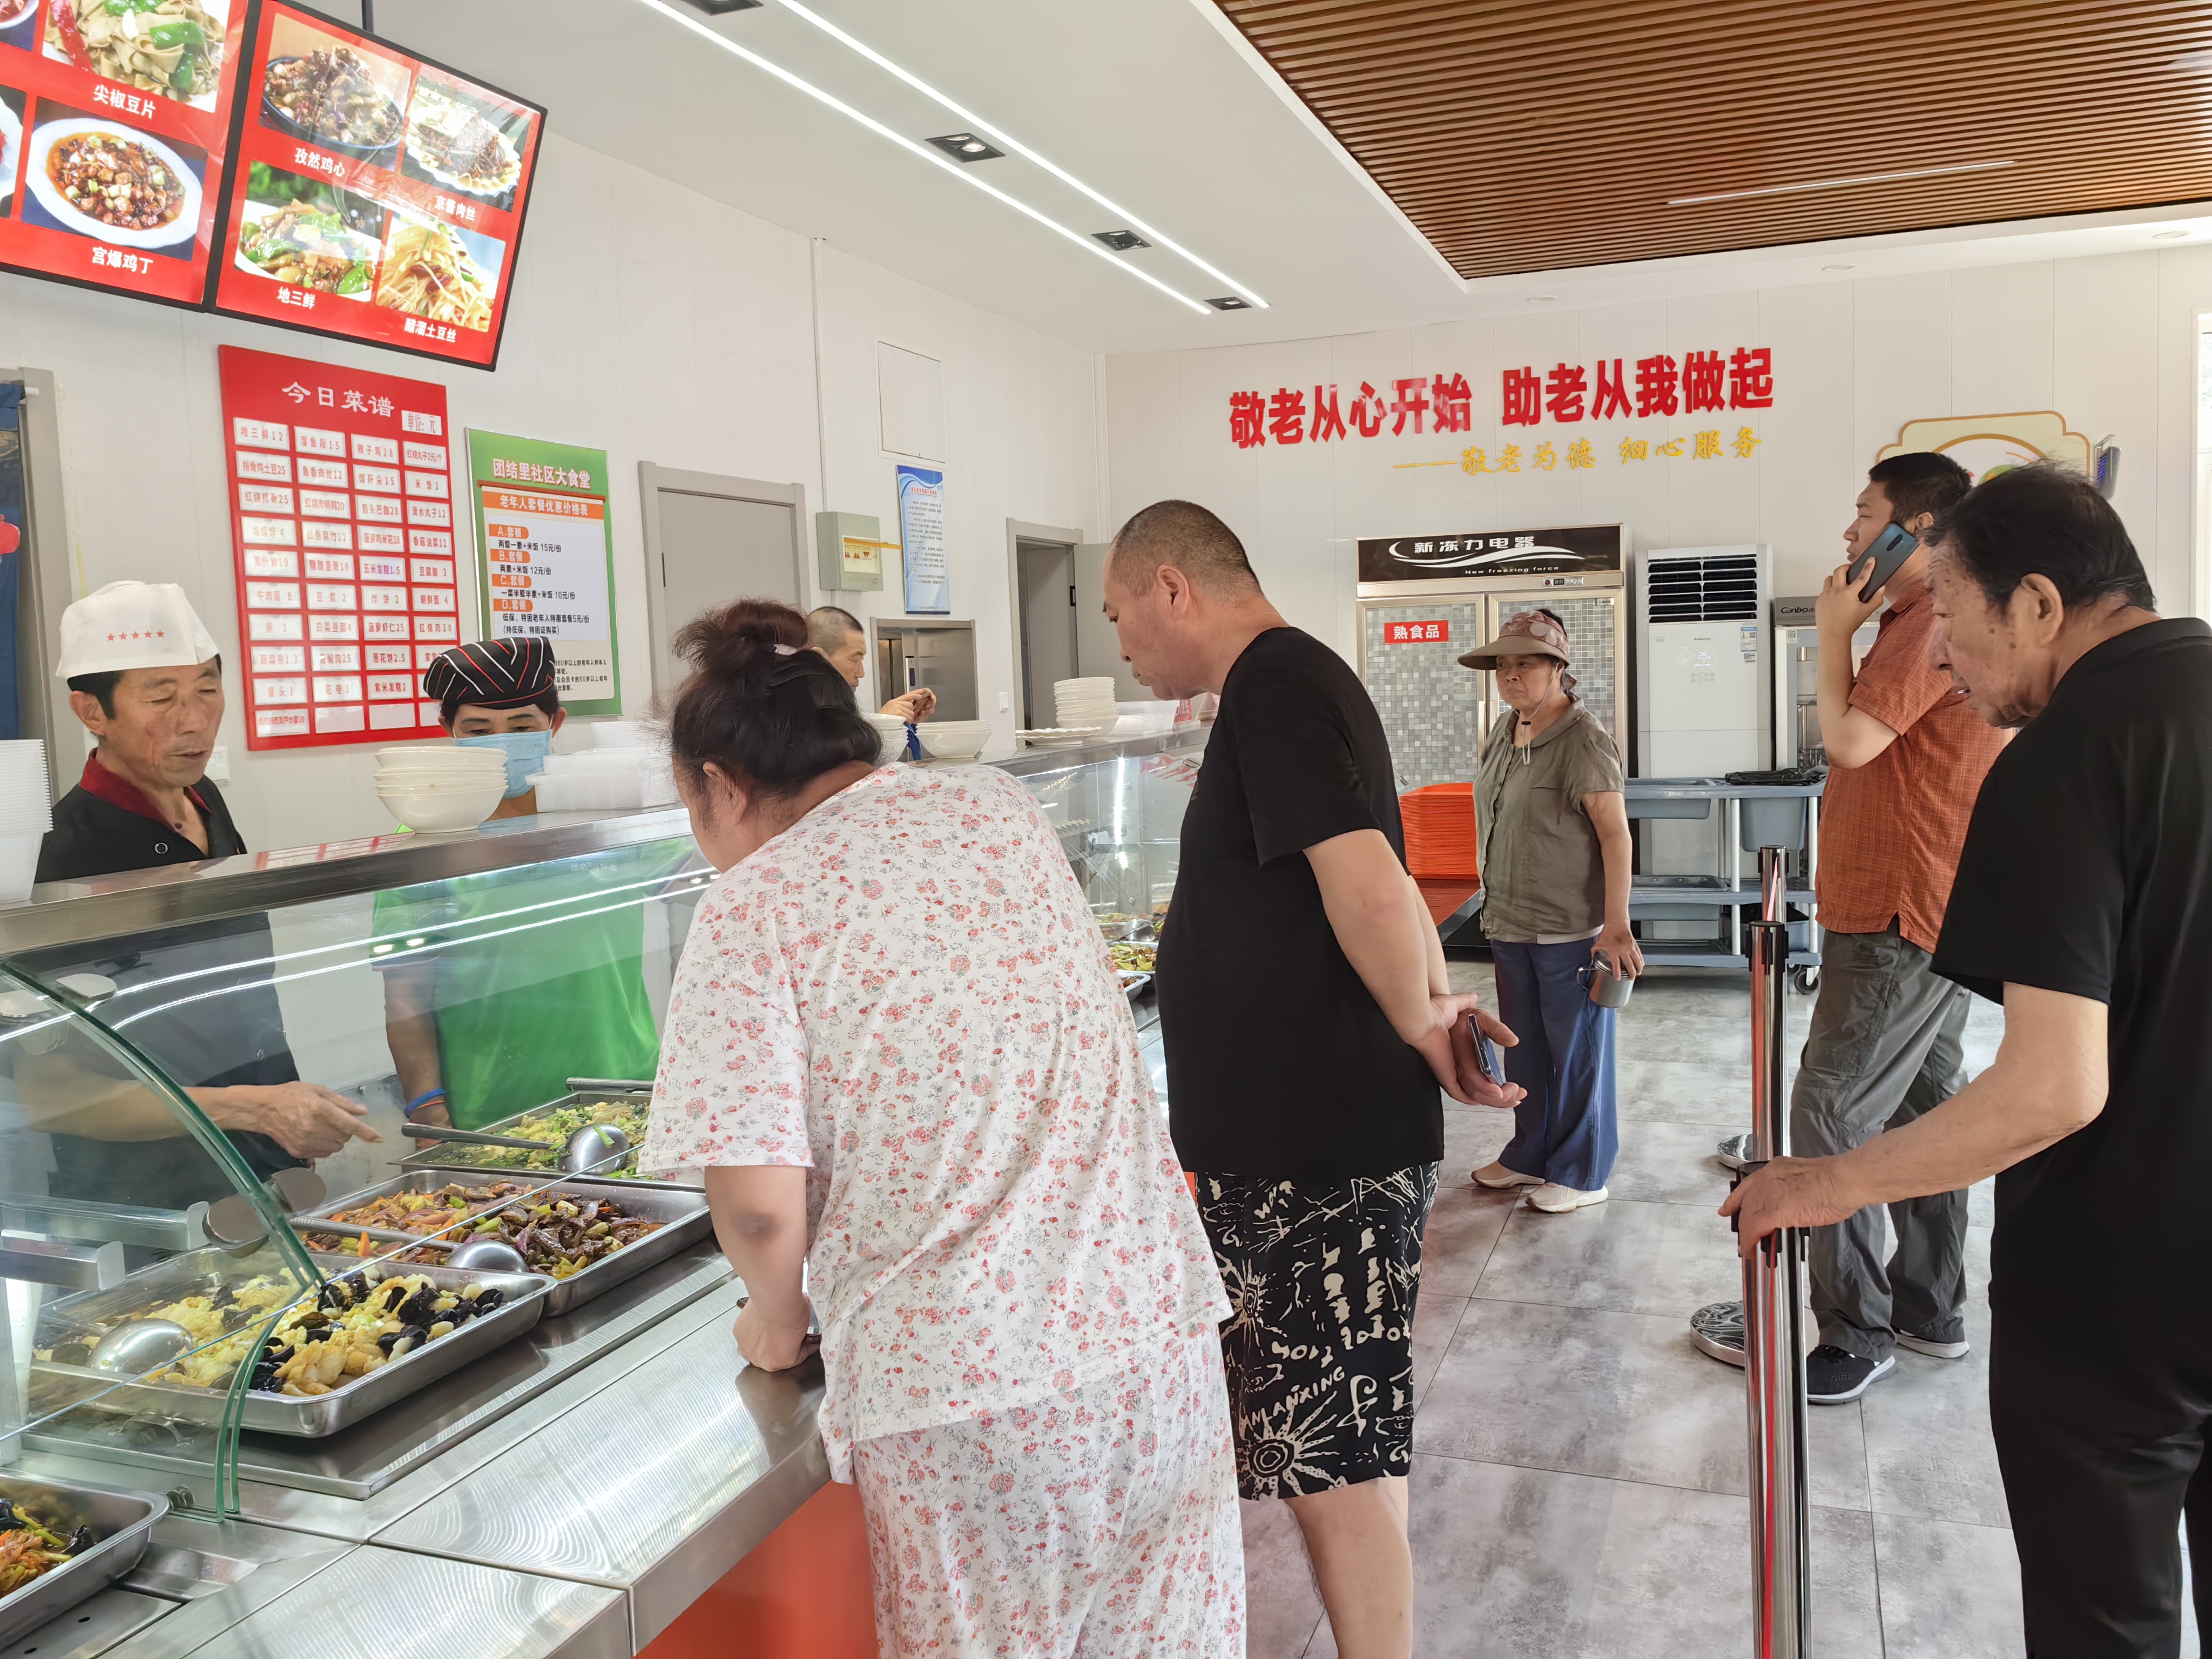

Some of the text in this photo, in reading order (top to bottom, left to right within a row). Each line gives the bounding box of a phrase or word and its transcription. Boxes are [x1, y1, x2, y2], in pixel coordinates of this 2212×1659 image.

[93, 84, 156, 119] 尖椒豆片
[295, 147, 346, 177] 孜然鸡心
[435, 195, 476, 221] 京酱肉丝
[91, 247, 153, 274] 宫爆鸡丁
[278, 287, 315, 309] 地三鲜
[404, 318, 457, 343] 醋溜土豆丝
[282, 381, 394, 417] 今日菜谱
[1230, 347, 1774, 449] 敬老从心开始 助老从我做起
[1620, 426, 1763, 465] 细心服务
[493, 458, 591, 489] 团结里社区大食堂
[500, 494, 589, 516] 老年人套餐优惠价格表
[498, 526, 522, 538] A.套餐
[499, 550, 523, 562] B.套餐
[541, 543, 562, 553] 15元/份
[1414, 536, 1534, 554] 新冻力电器
[500, 564, 551, 575] 两素+米饭 12元/份
[500, 575, 525, 586] C.套餐
[502, 599, 527, 611] D.套餐
[555, 591, 575, 600] 10元/份
[1393, 624, 1440, 640] 熟食品
